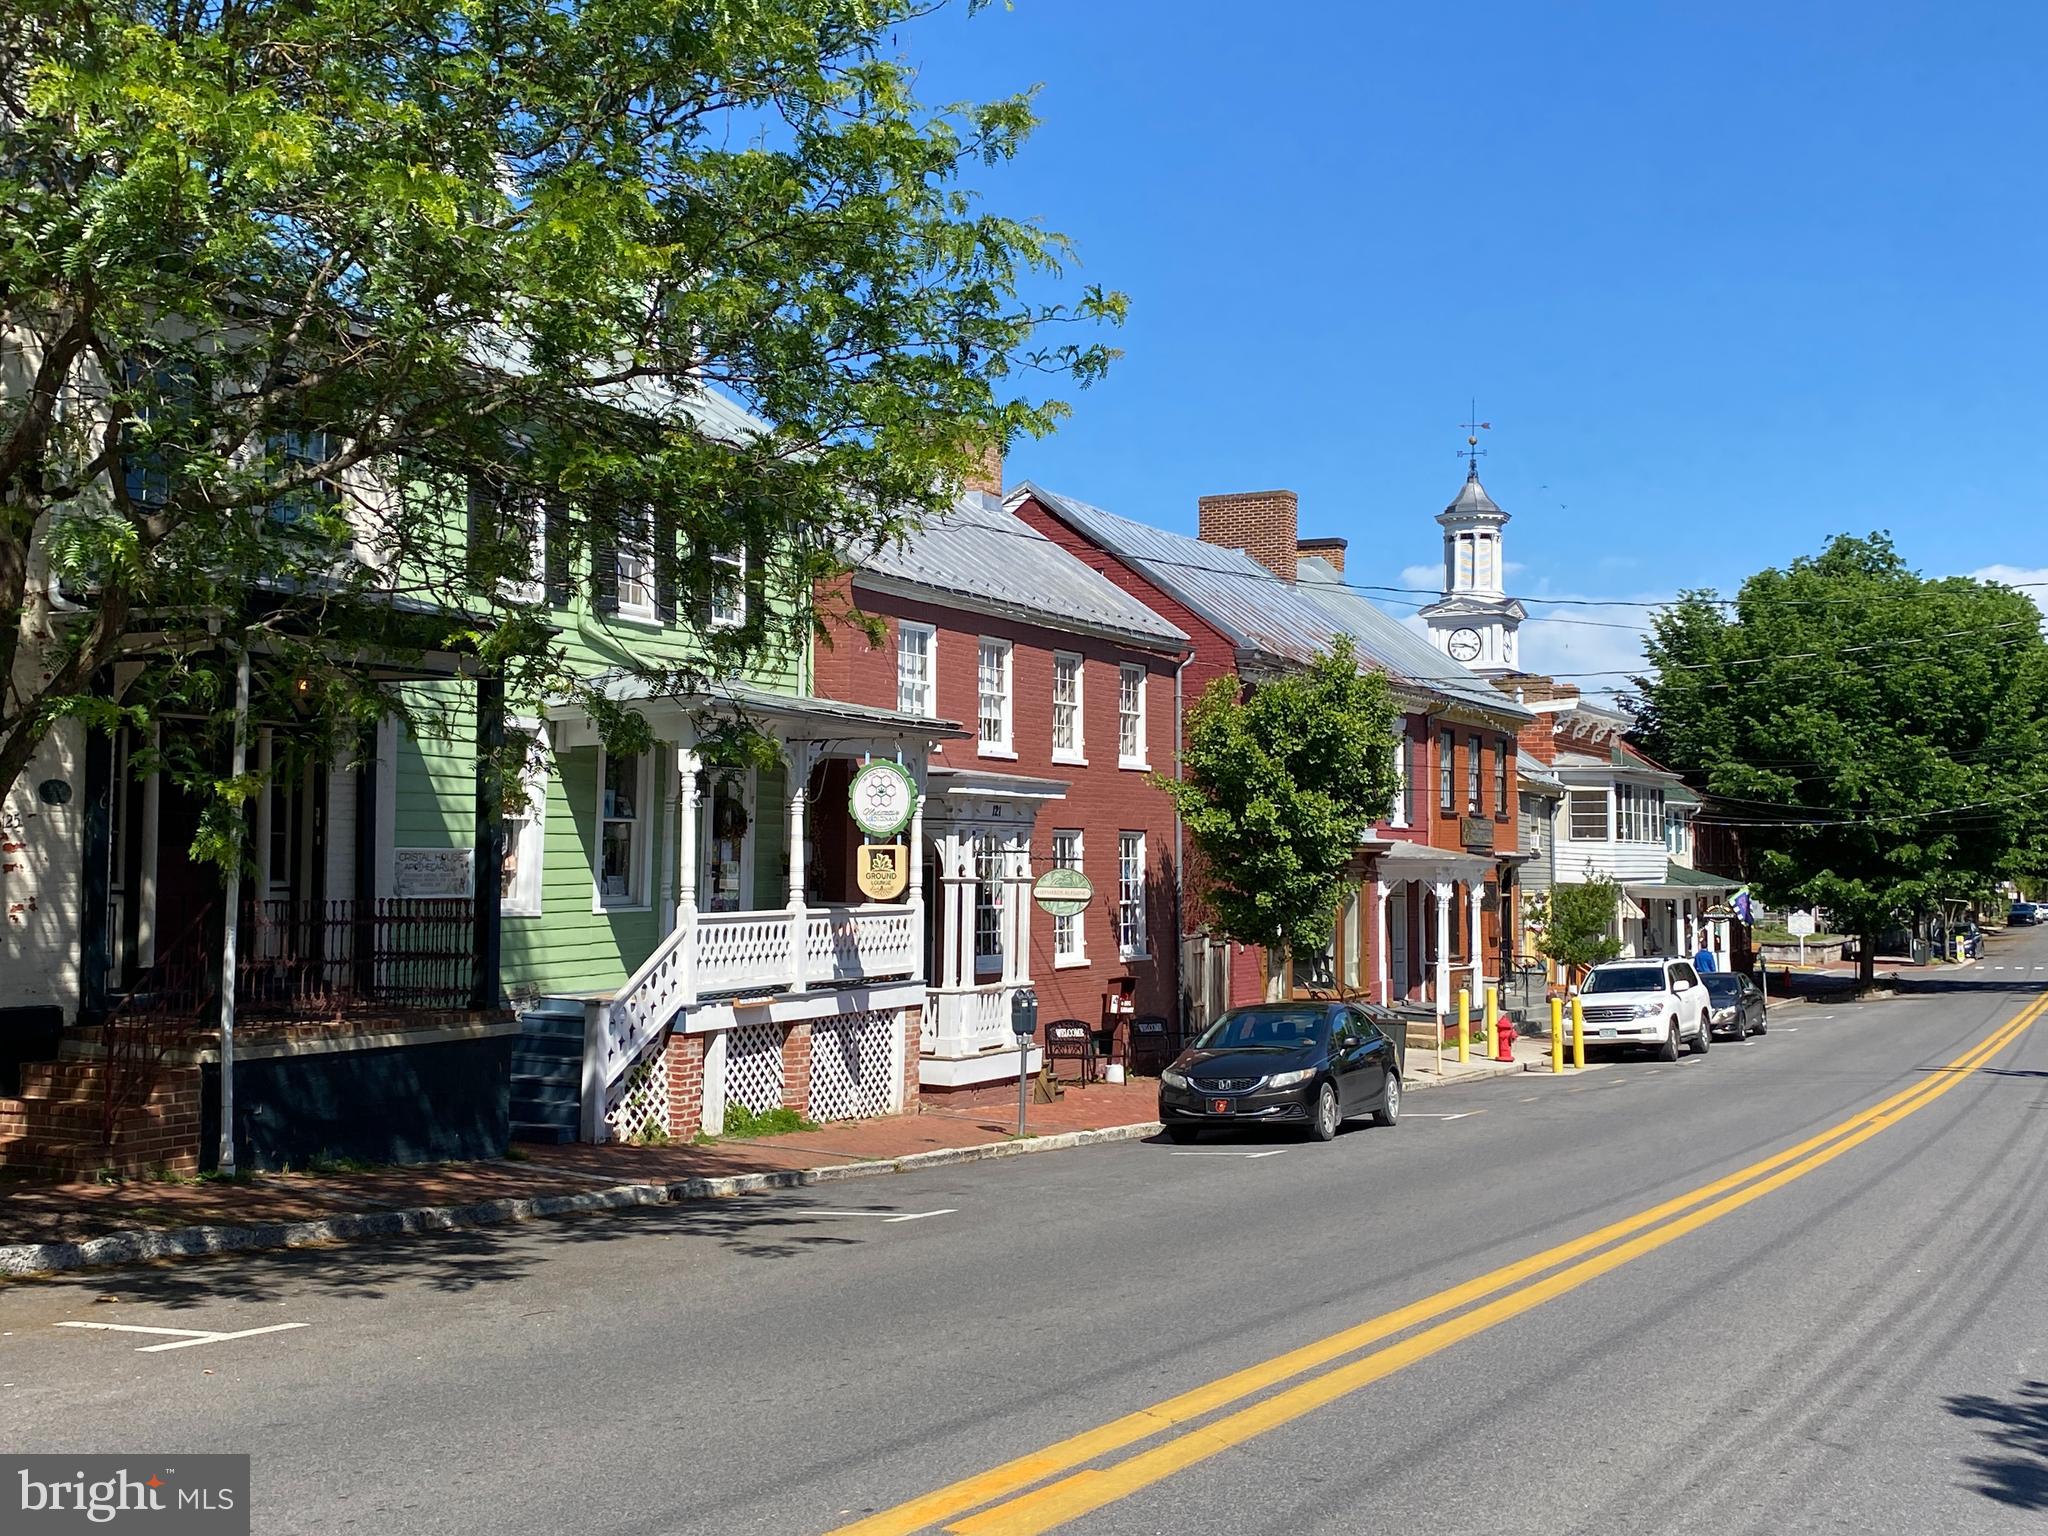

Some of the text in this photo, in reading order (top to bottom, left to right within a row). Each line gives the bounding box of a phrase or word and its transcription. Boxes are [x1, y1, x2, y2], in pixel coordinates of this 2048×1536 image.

[992, 804, 1002, 817] 121
[435, 852, 464, 862] HOUSE
[865, 872, 898, 880] GROUND
[1055, 1028, 1085, 1038] WELCOME
